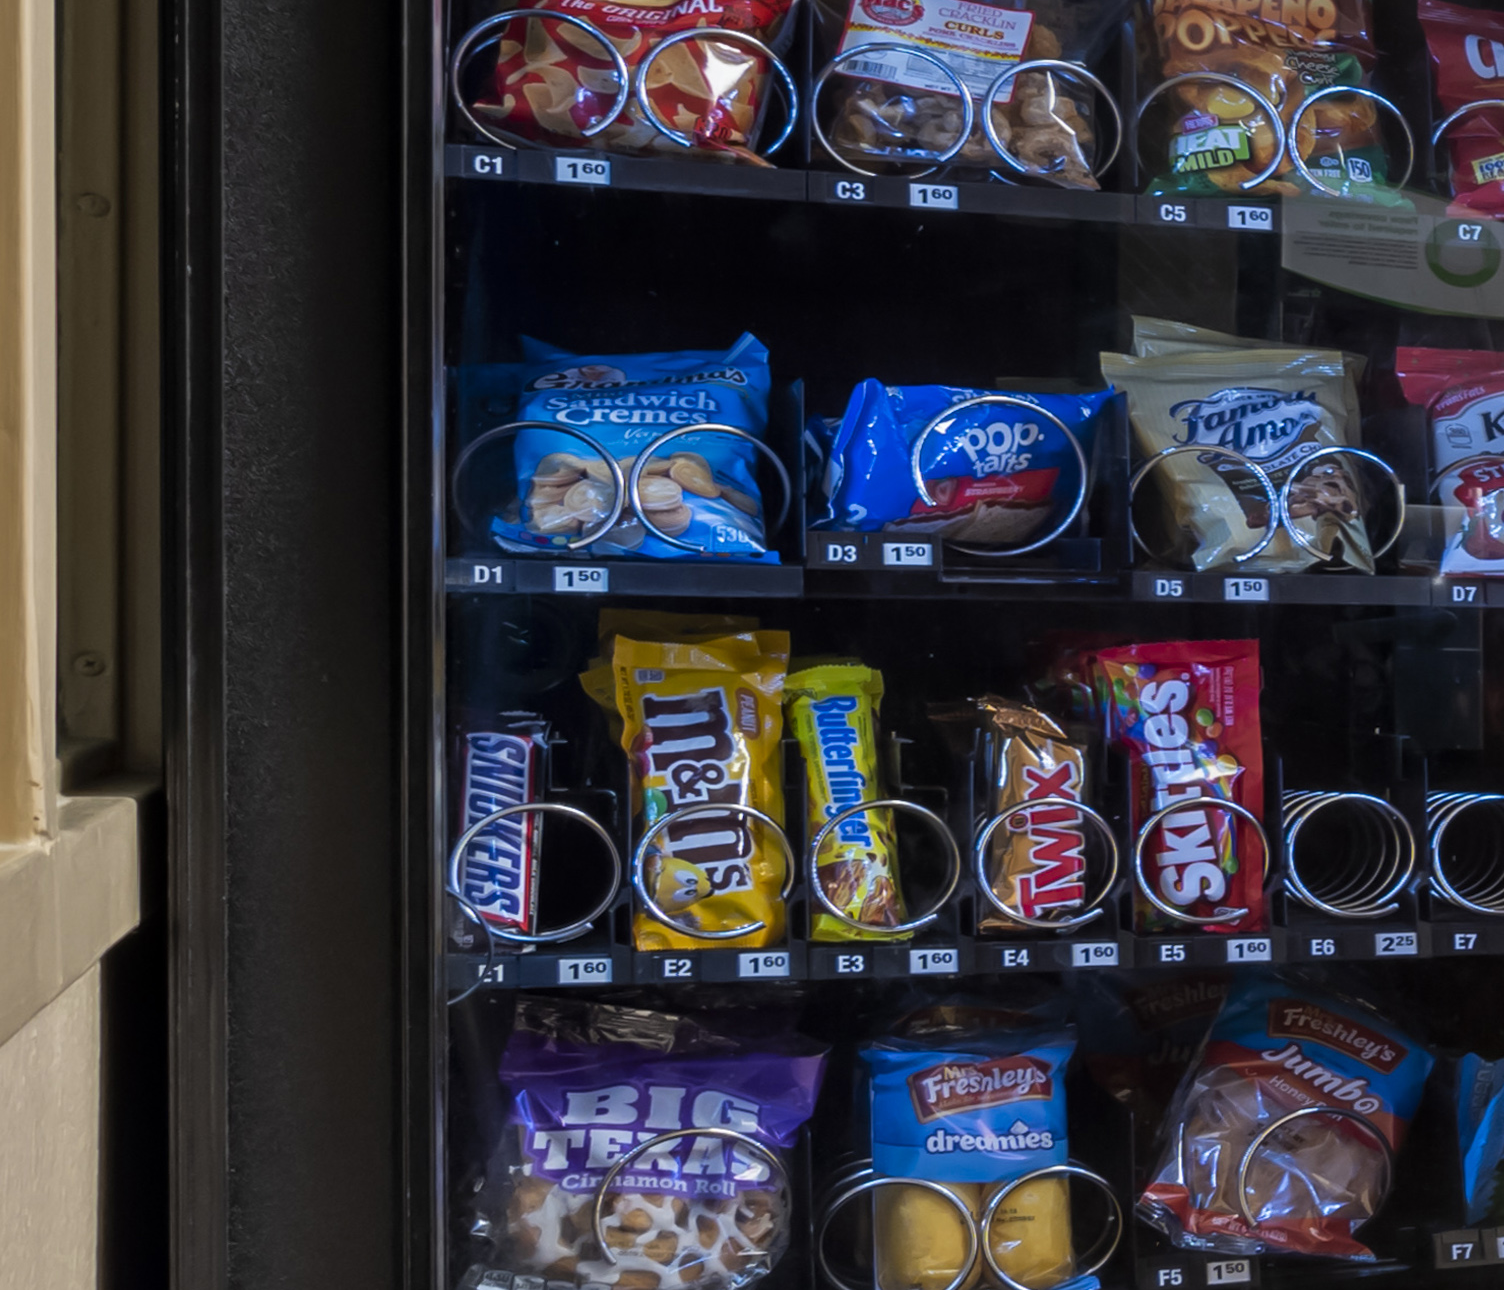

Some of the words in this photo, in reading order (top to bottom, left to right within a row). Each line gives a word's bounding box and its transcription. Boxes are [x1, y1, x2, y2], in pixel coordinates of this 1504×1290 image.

[944, 21, 1004, 40] CURLS
[474, 154, 504, 174] C1
[1178, 149, 1235, 173] MILD
[836, 181, 865, 201] C3
[1160, 204, 1187, 223] C5
[1458, 224, 1483, 242] C7
[546, 391, 718, 411] Sandwich
[555, 408, 709, 425] Cremes
[974, 449, 1032, 478] tarts
[827, 543, 858, 562] D3
[474, 564, 504, 584] D1
[1155, 579, 1183, 598] D5
[1452, 585, 1478, 603] D7
[736, 691, 758, 734] PEANUT
[466, 734, 530, 922] SNICKERS
[1311, 939, 1335, 956] E6
[1453, 933, 1477, 951] E7
[1003, 948, 1029, 967] E4
[1160, 944, 1185, 962] E5
[478, 963, 504, 983] E1
[664, 959, 692, 978] E2
[837, 954, 865, 973] E3
[1282, 1007, 1398, 1064] Freshley's
[1261, 1044, 1381, 1115] Jumbo
[565, 1084, 760, 1132] BIG
[926, 1120, 1054, 1154] dreamies
[532, 1129, 772, 1182] TEXAS
[695, 1179, 736, 1199] Roll
[1451, 1243, 1474, 1261] F7
[1158, 1268, 1183, 1286] F5
